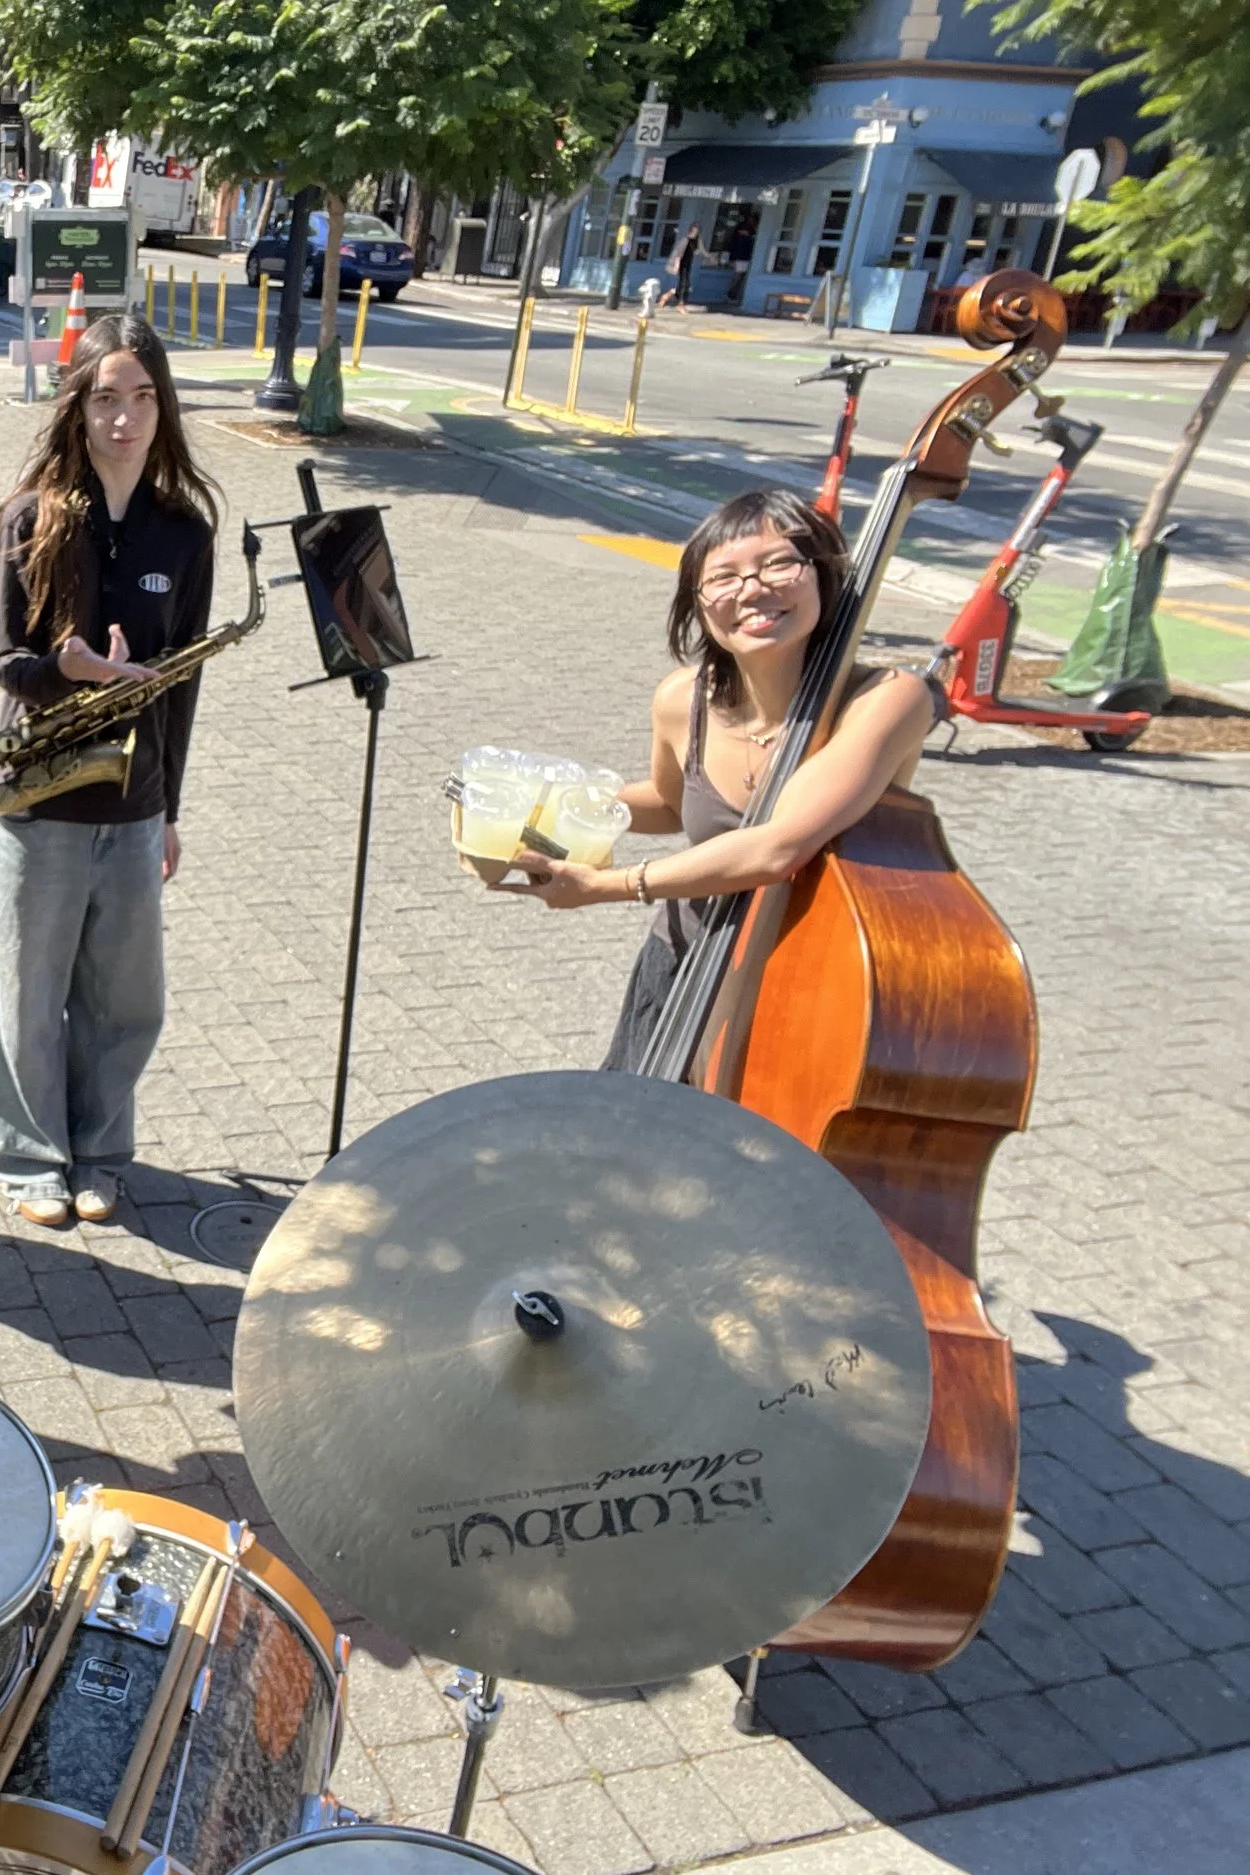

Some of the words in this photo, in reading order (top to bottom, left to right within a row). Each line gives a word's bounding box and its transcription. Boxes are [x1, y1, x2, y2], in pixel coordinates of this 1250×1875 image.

[639, 125, 661, 142] 20
[132, 151, 195, 181] FedEx
[592, 1448, 764, 1491] Mehmet
